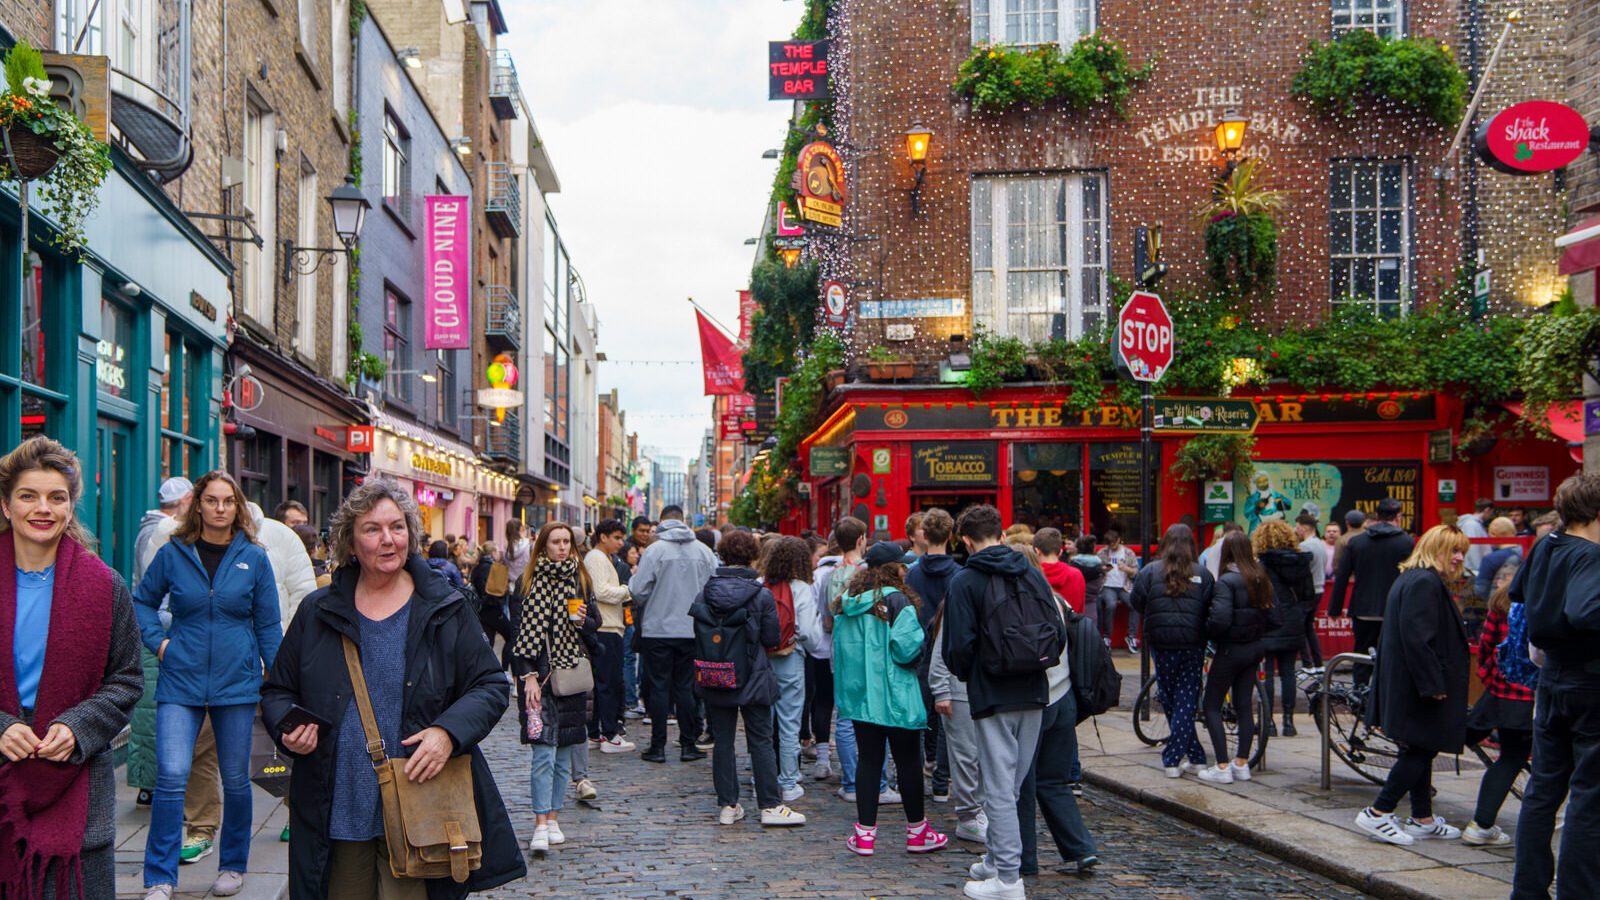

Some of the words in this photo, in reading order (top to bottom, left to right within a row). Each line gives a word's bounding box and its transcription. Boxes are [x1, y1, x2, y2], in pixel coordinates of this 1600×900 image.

[783, 44, 813, 58] THE
[770, 60, 827, 77] TEMPLE
[784, 79, 814, 94] BAR
[1192, 87, 1244, 106] THE
[1135, 108, 1238, 147] TEMPL
[1249, 111, 1301, 145] BAR
[1521, 116, 1535, 127] The
[1529, 140, 1581, 150] Restaurant
[434, 201, 460, 251] NINE
[434, 259, 460, 328] CLOUD
[1122, 319, 1170, 354] STOP
[706, 371, 742, 379] TEMPLE
[715, 378, 734, 386] BAR
[991, 407, 1063, 428] THE
[1259, 402, 1304, 422] AR
[1216, 405, 1249, 423] Reserve
[350, 431, 371, 447] PI
[925, 458, 986, 479] TOBACCO
[1294, 468, 1320, 479] THE
[1496, 469, 1546, 480] GUINNESS
[1281, 478, 1333, 490] TEMPLE
[1294, 488, 1320, 500] BAR
[1386, 485, 1414, 499] THE
[1313, 617, 1353, 629] TEMP
